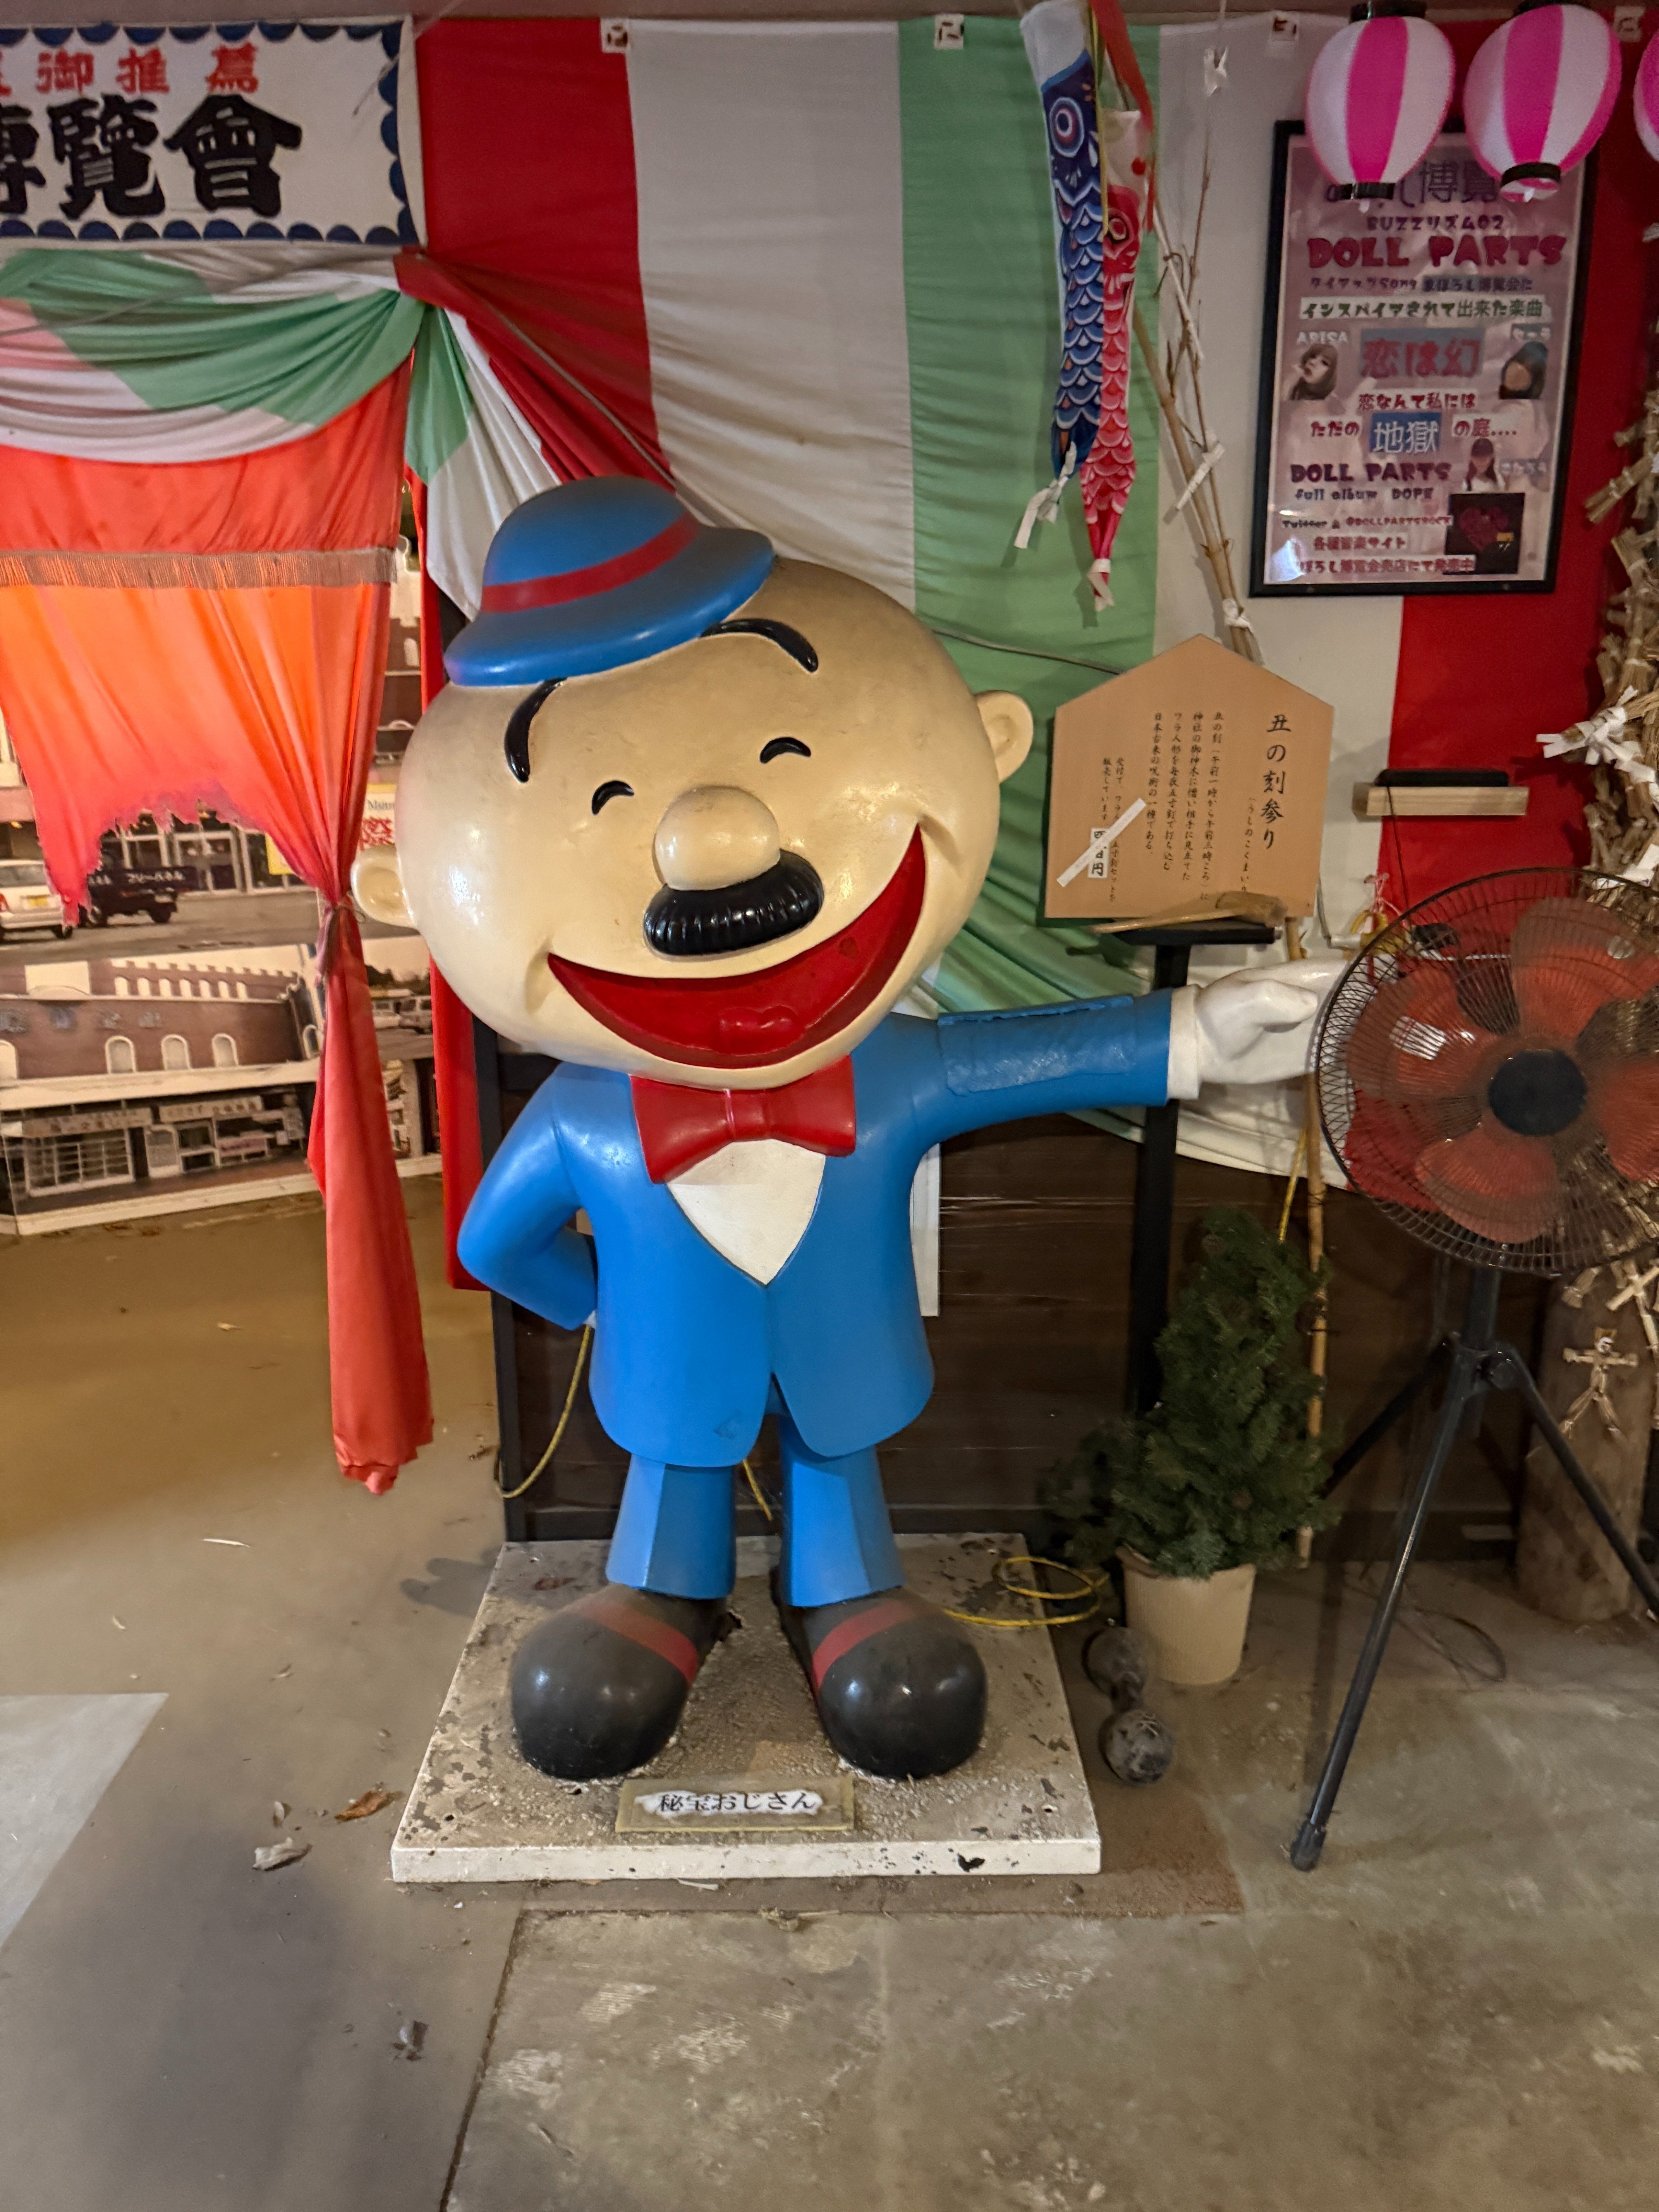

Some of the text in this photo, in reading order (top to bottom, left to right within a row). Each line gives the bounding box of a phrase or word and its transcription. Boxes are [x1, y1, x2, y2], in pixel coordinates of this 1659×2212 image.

[0, 42, 259, 96] 御推薦
[1307, 235, 1567, 269] DOLL PARTS
[1302, 299, 1543, 319] インスパイアされて出来た楽曲
[1358, 393, 1476, 410] 恋なんて私には
[1310, 421, 1360, 437] ただの
[1373, 420, 1439, 454] 地獄
[1291, 462, 1452, 483] DOLL PARTS
[1295, 488, 1434, 500] full album DOPE
[1260, 713, 1291, 850] 丑の刻参り
